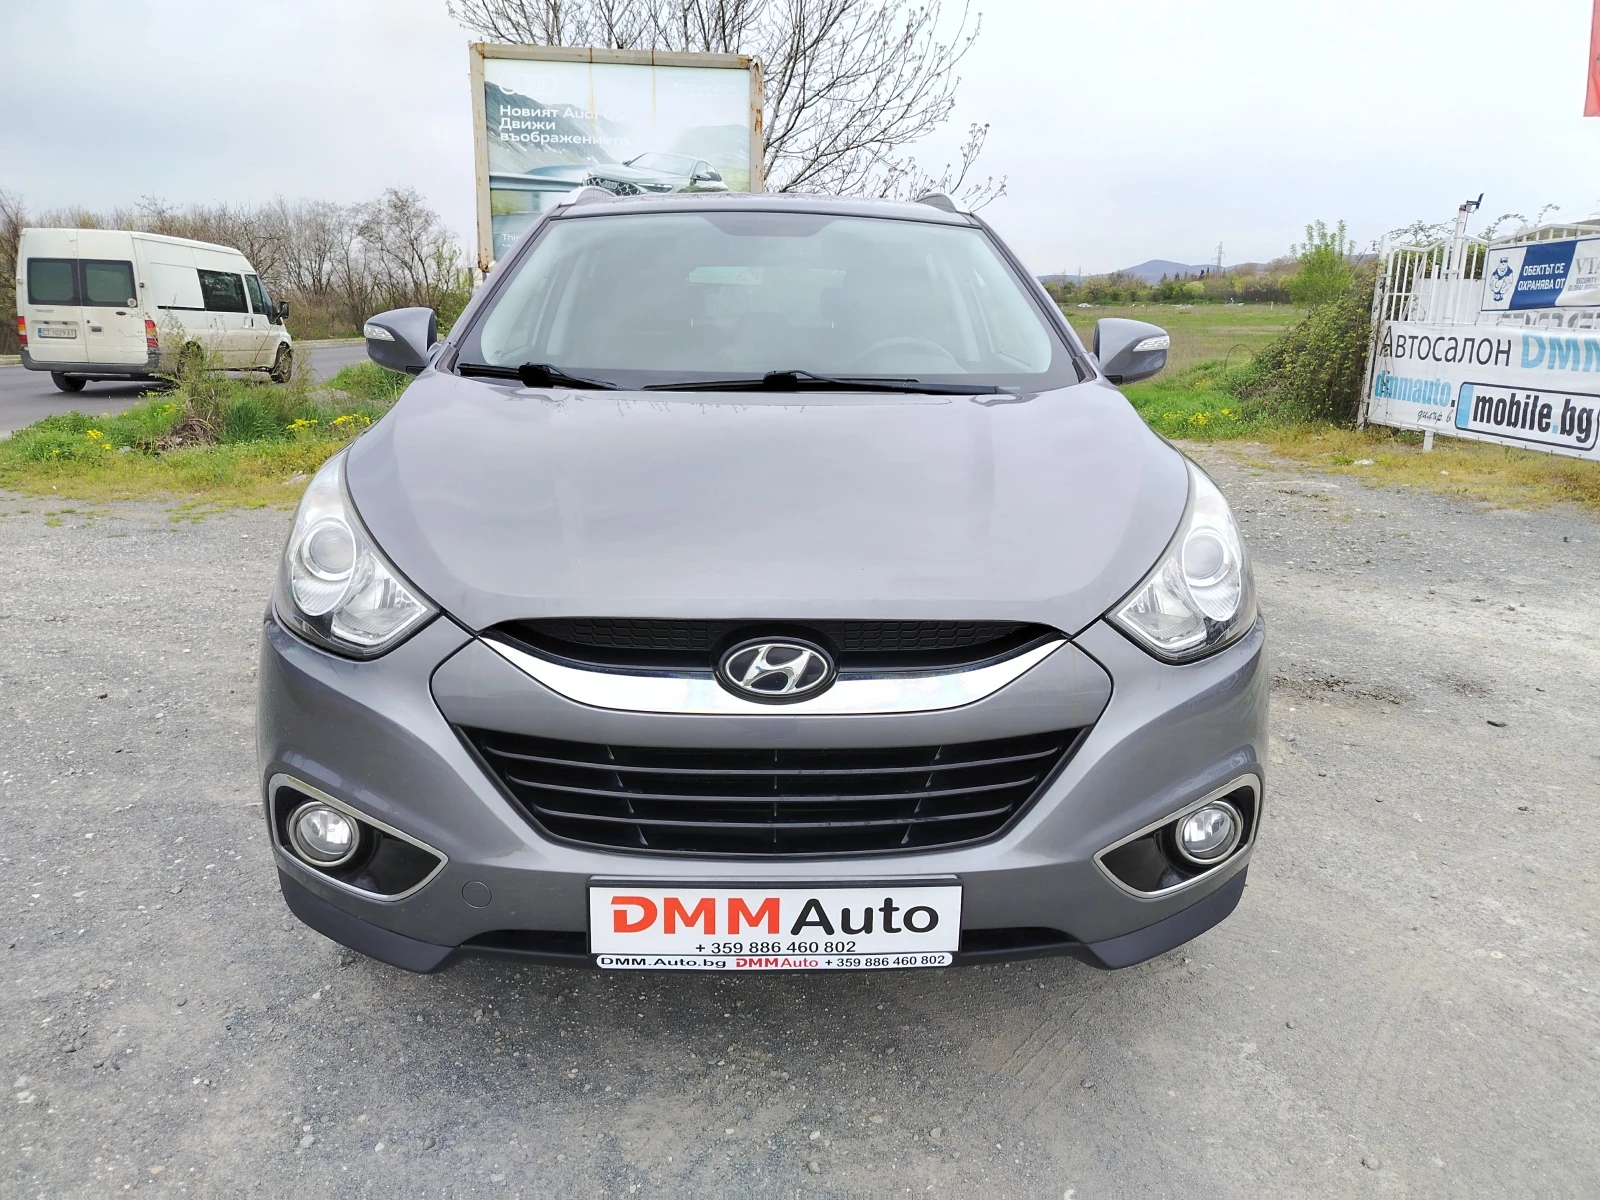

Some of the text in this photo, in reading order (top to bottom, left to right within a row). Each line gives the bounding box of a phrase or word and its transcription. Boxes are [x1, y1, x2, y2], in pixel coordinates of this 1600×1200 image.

[500, 105, 559, 118] Новият
[563, 107, 598, 120] Audi
[499, 117, 556, 131] Движи
[1523, 262, 1566, 276] ОБЕКТЪТ СЕ
[1517, 278, 1566, 291] ОХРАНЯВА ОТ
[1378, 326, 1513, 367] Автосалон
[1472, 393, 1595, 444] mobile.bg
[611, 896, 939, 936] DMM Auto
[711, 942, 743, 954] 359
[749, 942, 781, 954] 886
[786, 941, 819, 953] 460
[824, 941, 856, 953] 802
[600, 957, 727, 969] DMM.Auto.bg
[836, 957, 861, 968] 359
[864, 956, 889, 967] 886
[893, 955, 917, 966] 460
[920, 954, 945, 965] 802
